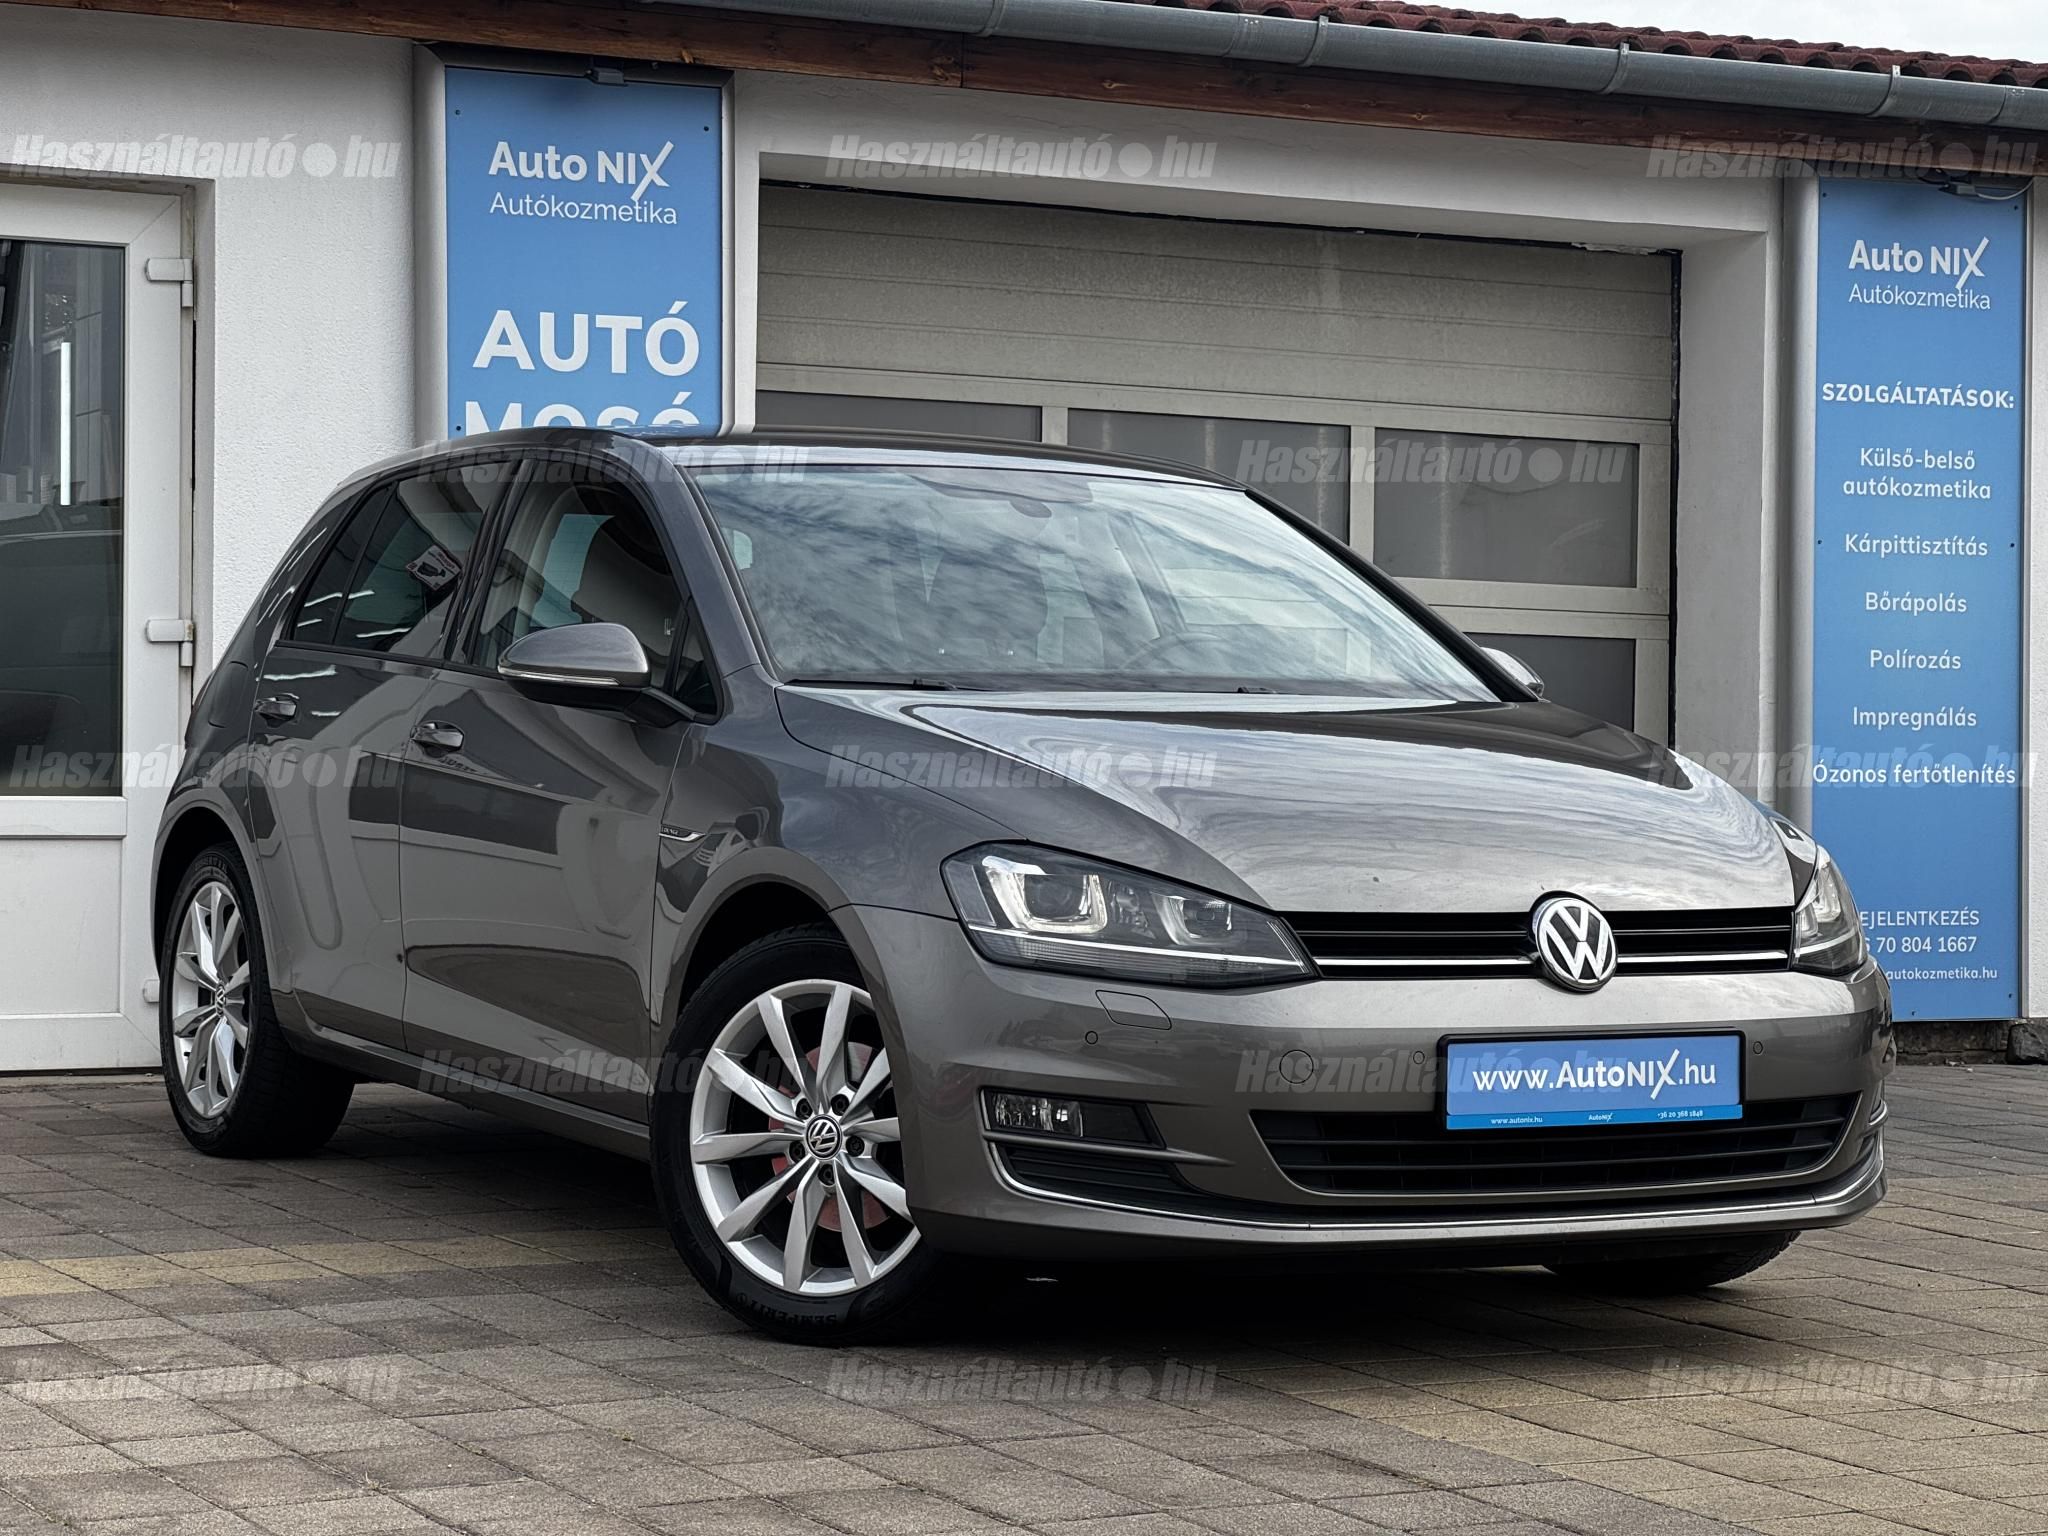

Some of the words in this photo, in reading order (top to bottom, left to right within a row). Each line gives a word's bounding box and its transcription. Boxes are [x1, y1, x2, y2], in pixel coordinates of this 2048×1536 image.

[488, 141, 588, 181] Auto
[597, 140, 674, 202] NIX
[489, 191, 677, 225] Autókozmetika
[1848, 239, 1924, 273] Auto
[1930, 236, 1989, 290] NIX
[1848, 283, 1991, 310] Autókozmetika
[472, 300, 700, 377] AUTÓ
[1822, 382, 2015, 408] SZOLGÁLTATÁSOK:
[1860, 448, 1976, 471] Külső-belső
[1843, 478, 1991, 499] autókozmetika
[1844, 533, 1989, 559] Kárpittisztítás
[1864, 591, 1968, 615] Bőrápolás
[1870, 650, 1962, 670] Polírozás
[1853, 706, 1978, 730] Impregnálás
[1812, 758, 1887, 785] Ózonos
[1893, 763, 2016, 785] fertőtlenítés
[1860, 906, 1980, 930] EJELENTKEZÉS
[1876, 936, 1897, 953] 70
[1901, 936, 1932, 953] 804
[1938, 936, 1977, 953] 1667
[1886, 966, 1998, 981] autokozmetika.hu
[1472, 1049, 1717, 1100] www.AutoNIX.hu
